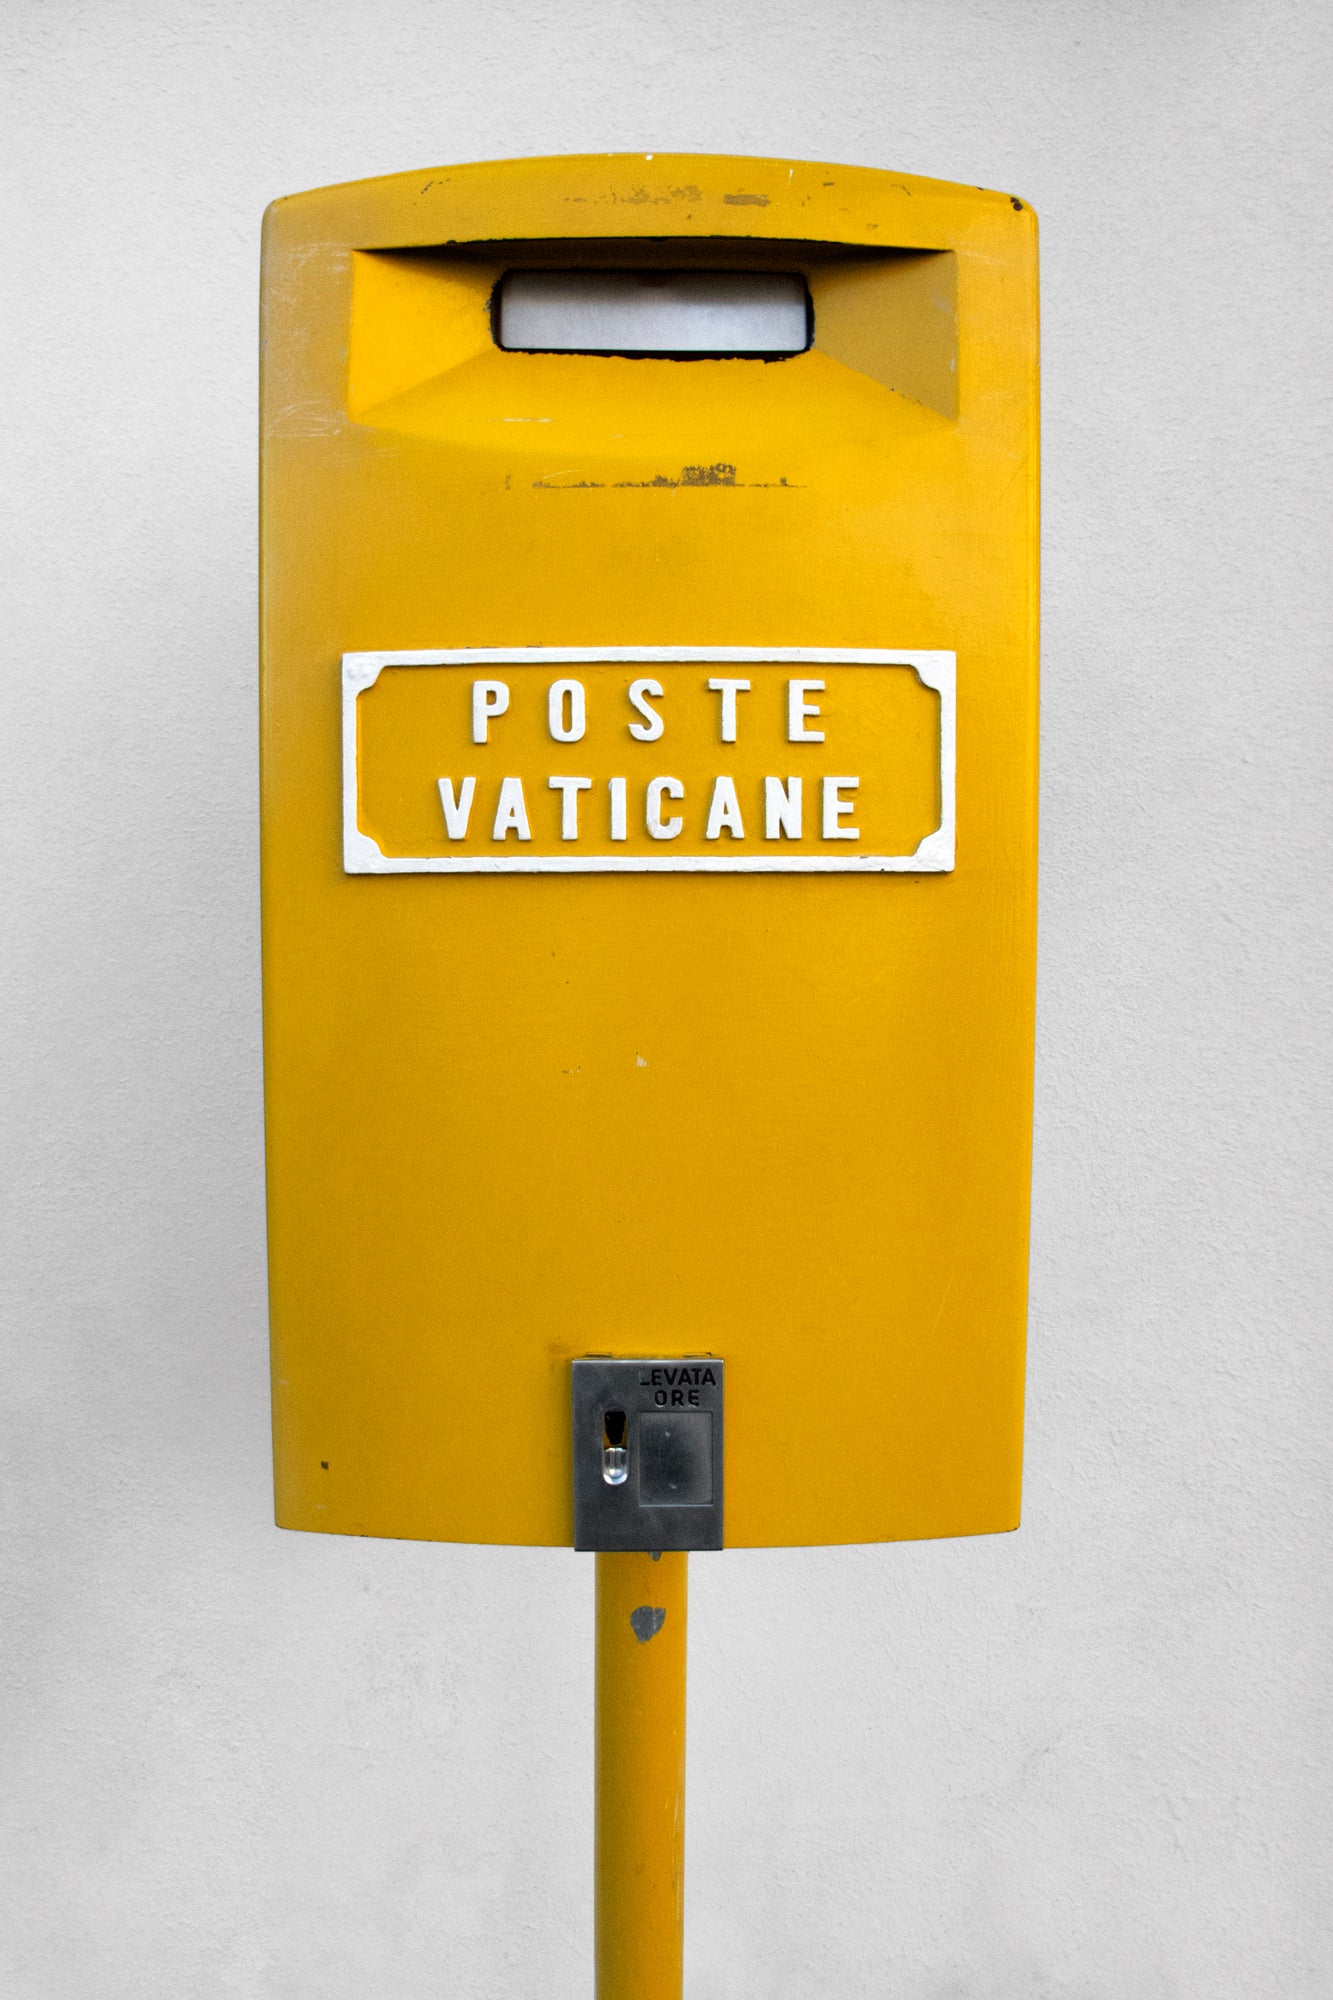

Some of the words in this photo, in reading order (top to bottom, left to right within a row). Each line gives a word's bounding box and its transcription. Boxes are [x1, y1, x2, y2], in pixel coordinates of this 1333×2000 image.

[472, 679, 826, 743] POSTE
[438, 776, 860, 841] VATICANE
[654, 1389, 701, 1407] ORE
